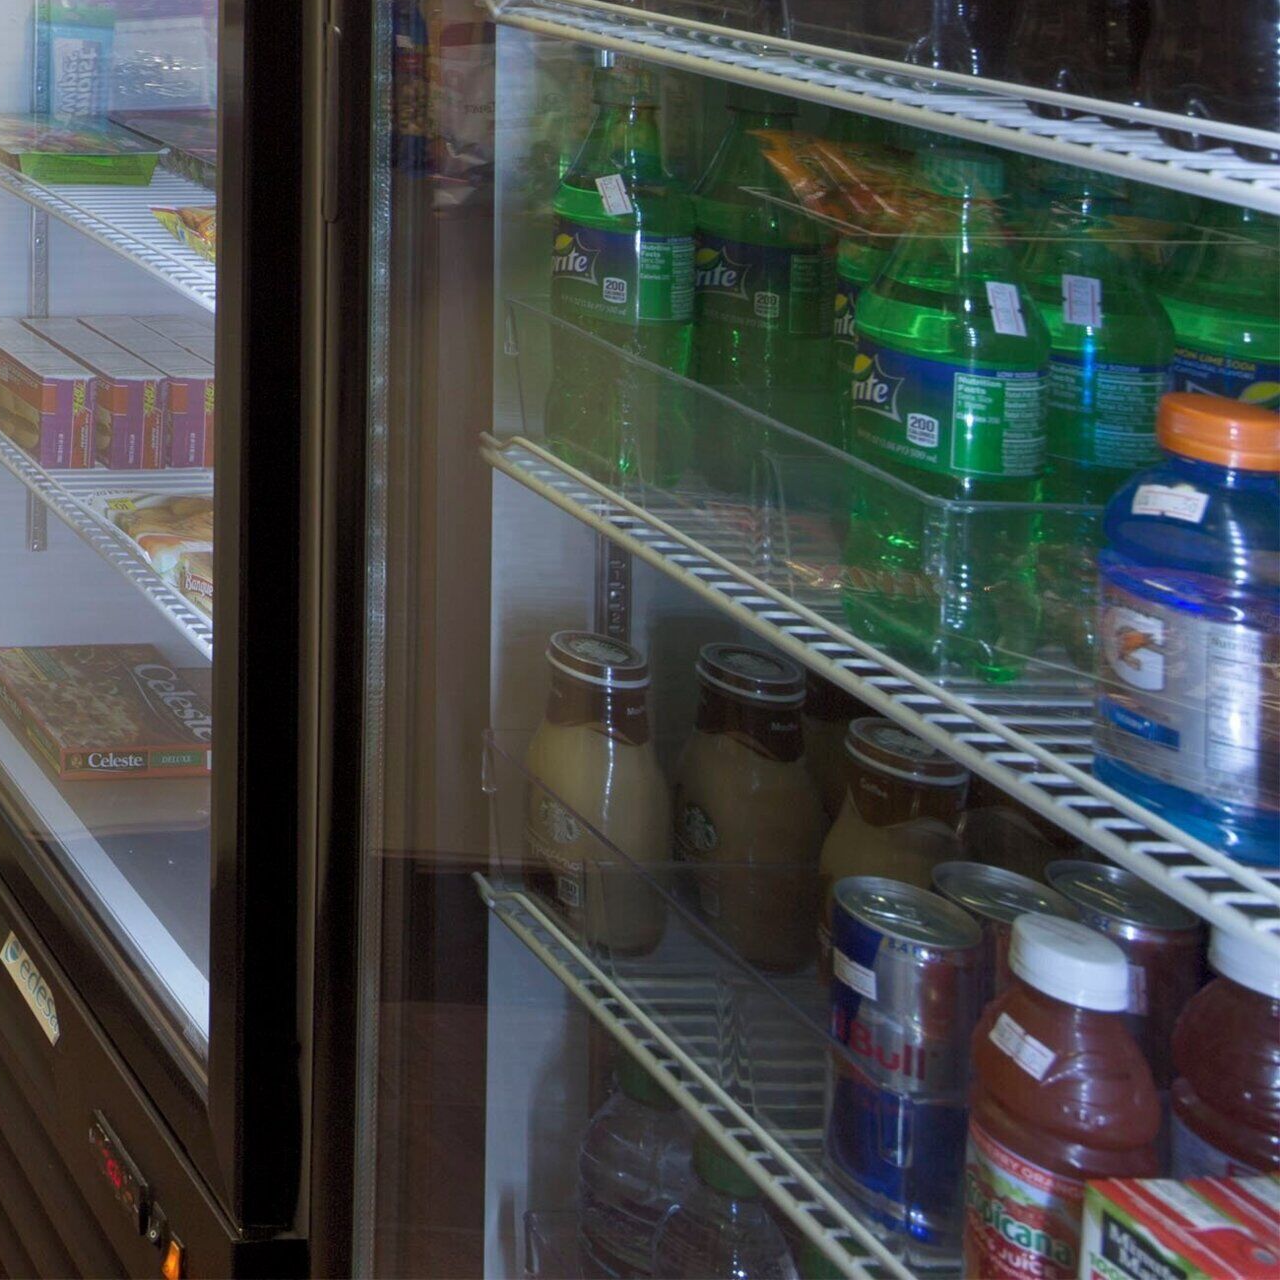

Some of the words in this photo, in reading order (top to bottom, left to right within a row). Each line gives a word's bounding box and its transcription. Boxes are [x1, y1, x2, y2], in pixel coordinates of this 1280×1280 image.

[605, 280, 624, 291] 200
[757, 294, 777, 305] 200
[1226, 357, 1256, 371] SODA
[958, 376, 1002, 388] Nutrition
[958, 385, 986, 395] Facts
[910, 417, 935, 432] 200
[87, 753, 144, 768] Celeste
[850, 1021, 926, 1080] Bull
